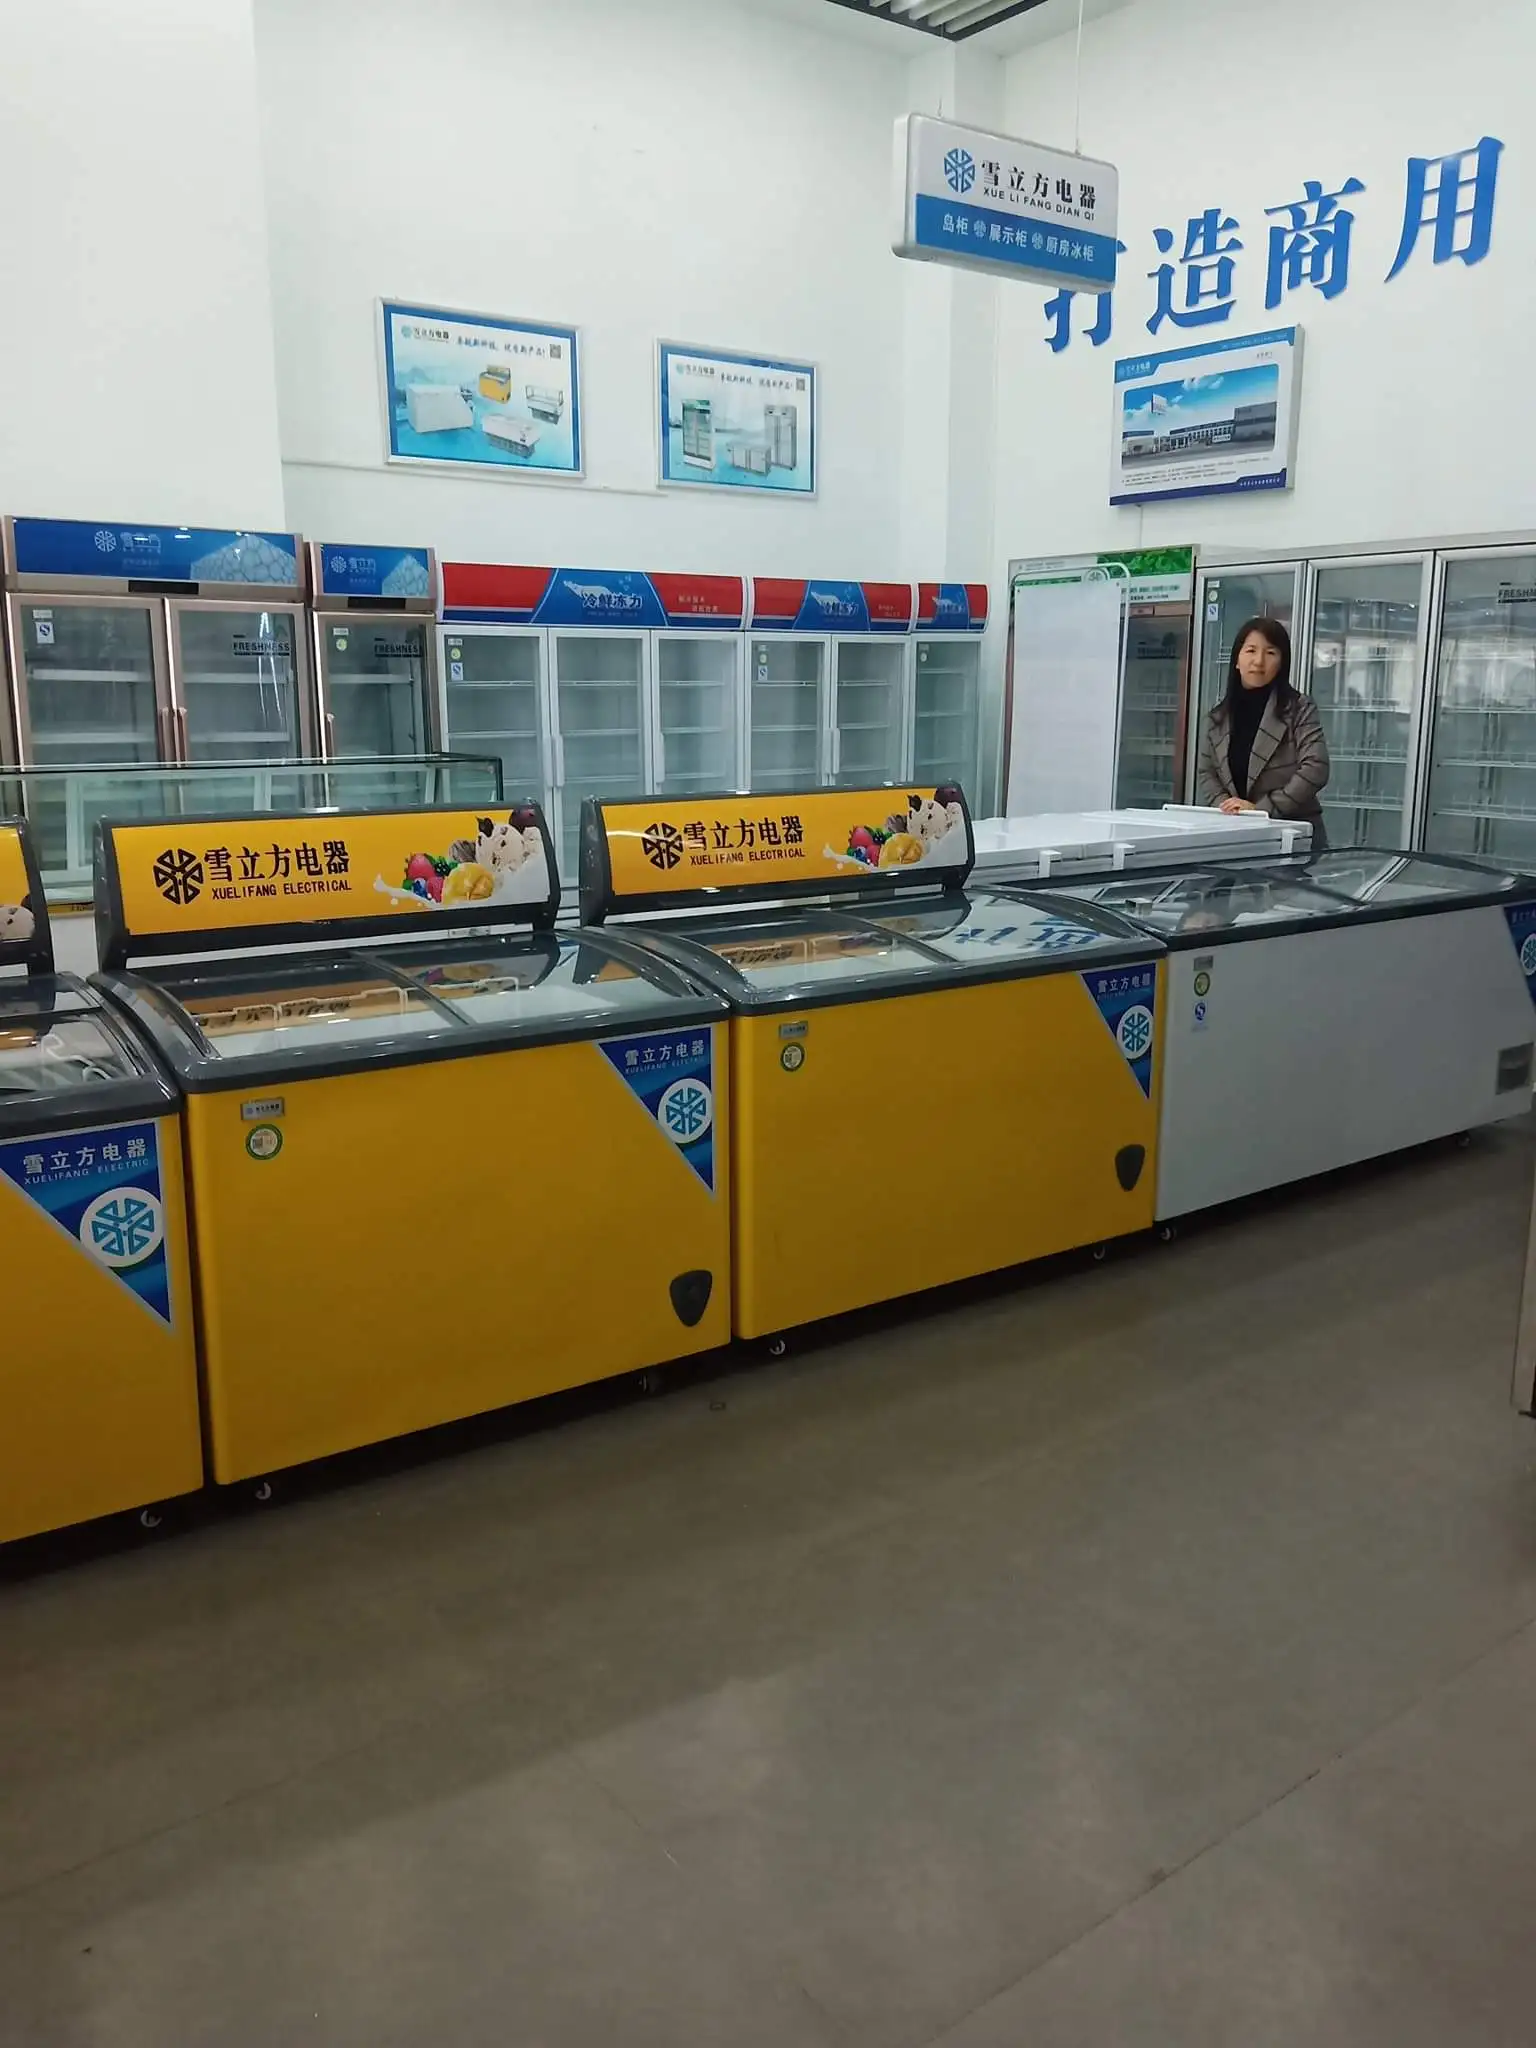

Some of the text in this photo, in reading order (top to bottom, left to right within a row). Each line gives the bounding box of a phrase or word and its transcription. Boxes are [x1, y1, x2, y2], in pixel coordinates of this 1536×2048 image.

[981, 160, 1096, 210] 雪立方电器
[983, 187, 1095, 221] XUE LI FANG DIAN QI
[942, 213, 1095, 262] 岛柜 展示柜 厨房冰柜
[233, 642, 290, 651] FRESHNESS
[683, 815, 803, 851] 雪立方电器
[204, 840, 350, 882] 雪立方电器
[690, 848, 806, 866] XUELIFANG ELECTRICAL
[212, 880, 352, 900] XUELIFANG ELECTRICAL
[625, 1039, 705, 1066] 雪立方电器
[23, 1138, 147, 1175] 雪立方电器
[24, 1158, 149, 1185] XUELIFANG ELECTRIC
